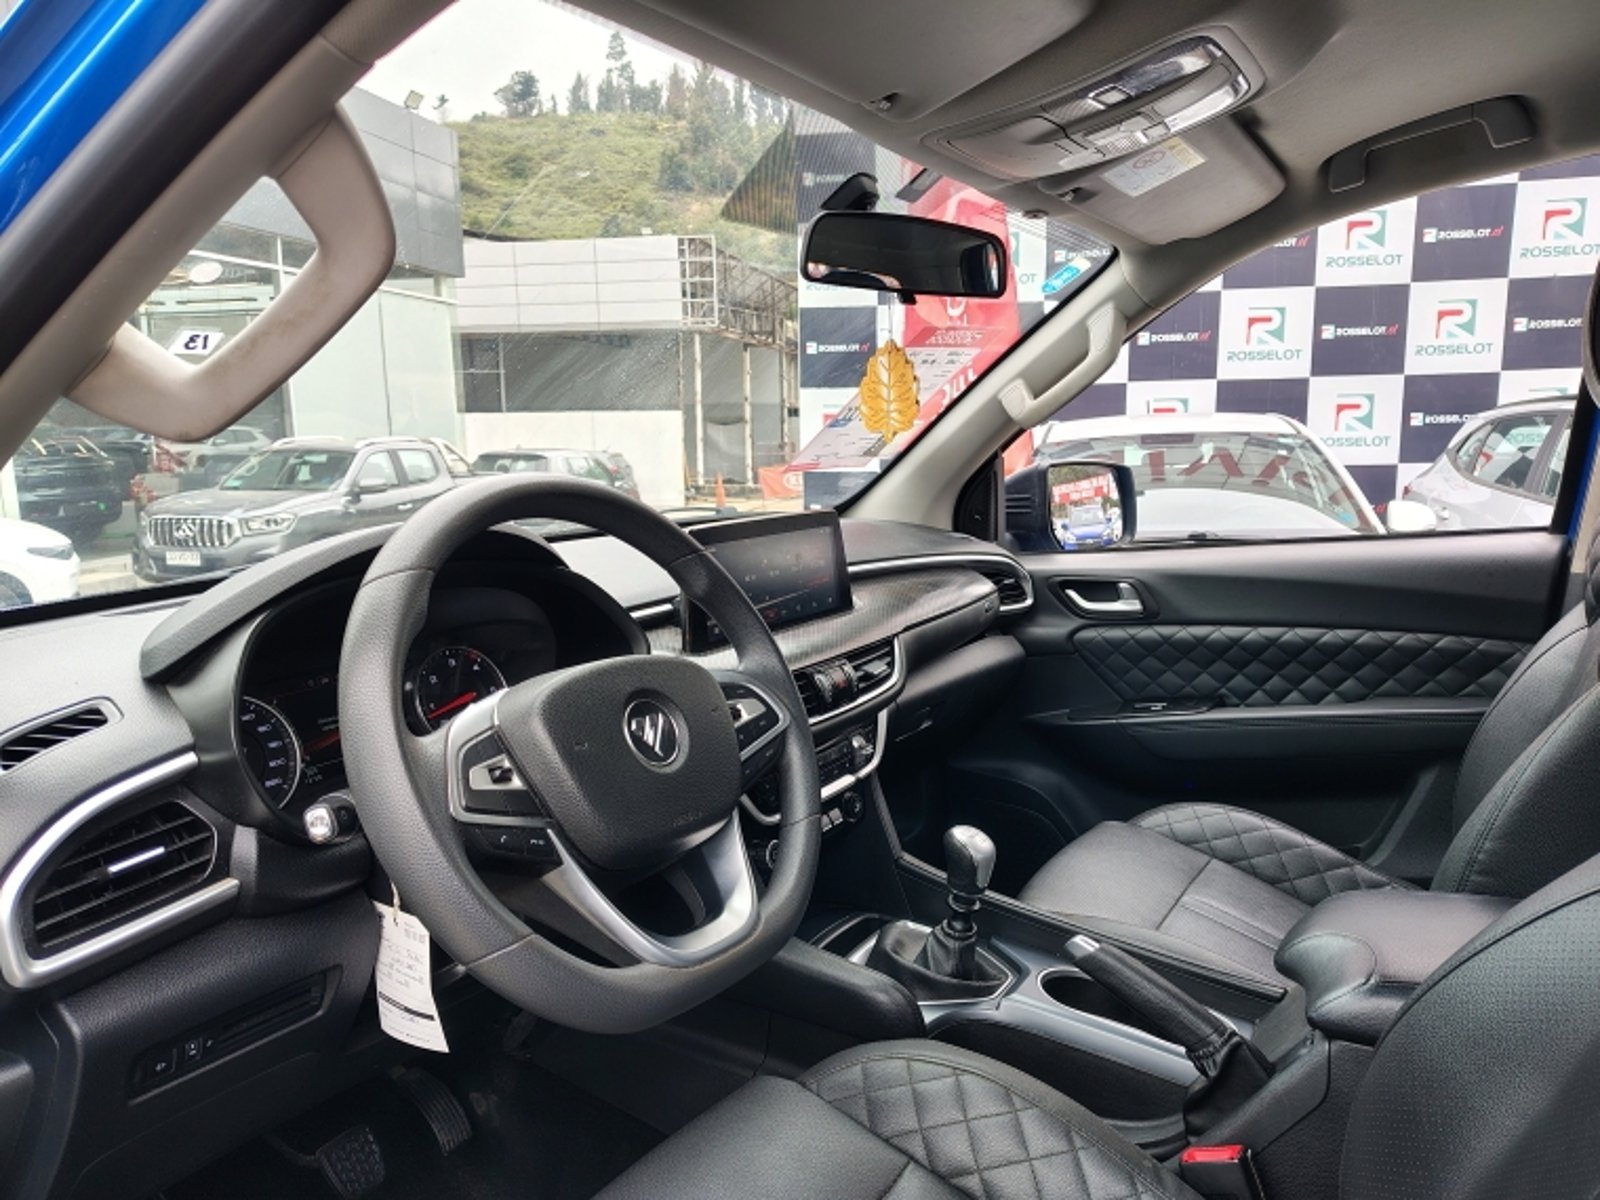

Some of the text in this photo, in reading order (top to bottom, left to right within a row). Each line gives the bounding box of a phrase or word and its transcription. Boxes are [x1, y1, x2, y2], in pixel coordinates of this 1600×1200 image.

[1325, 253, 1403, 268] ROSSELOT
[1226, 349, 1303, 362] ROSSELOT
[1414, 342, 1494, 357] ROSSELOT
